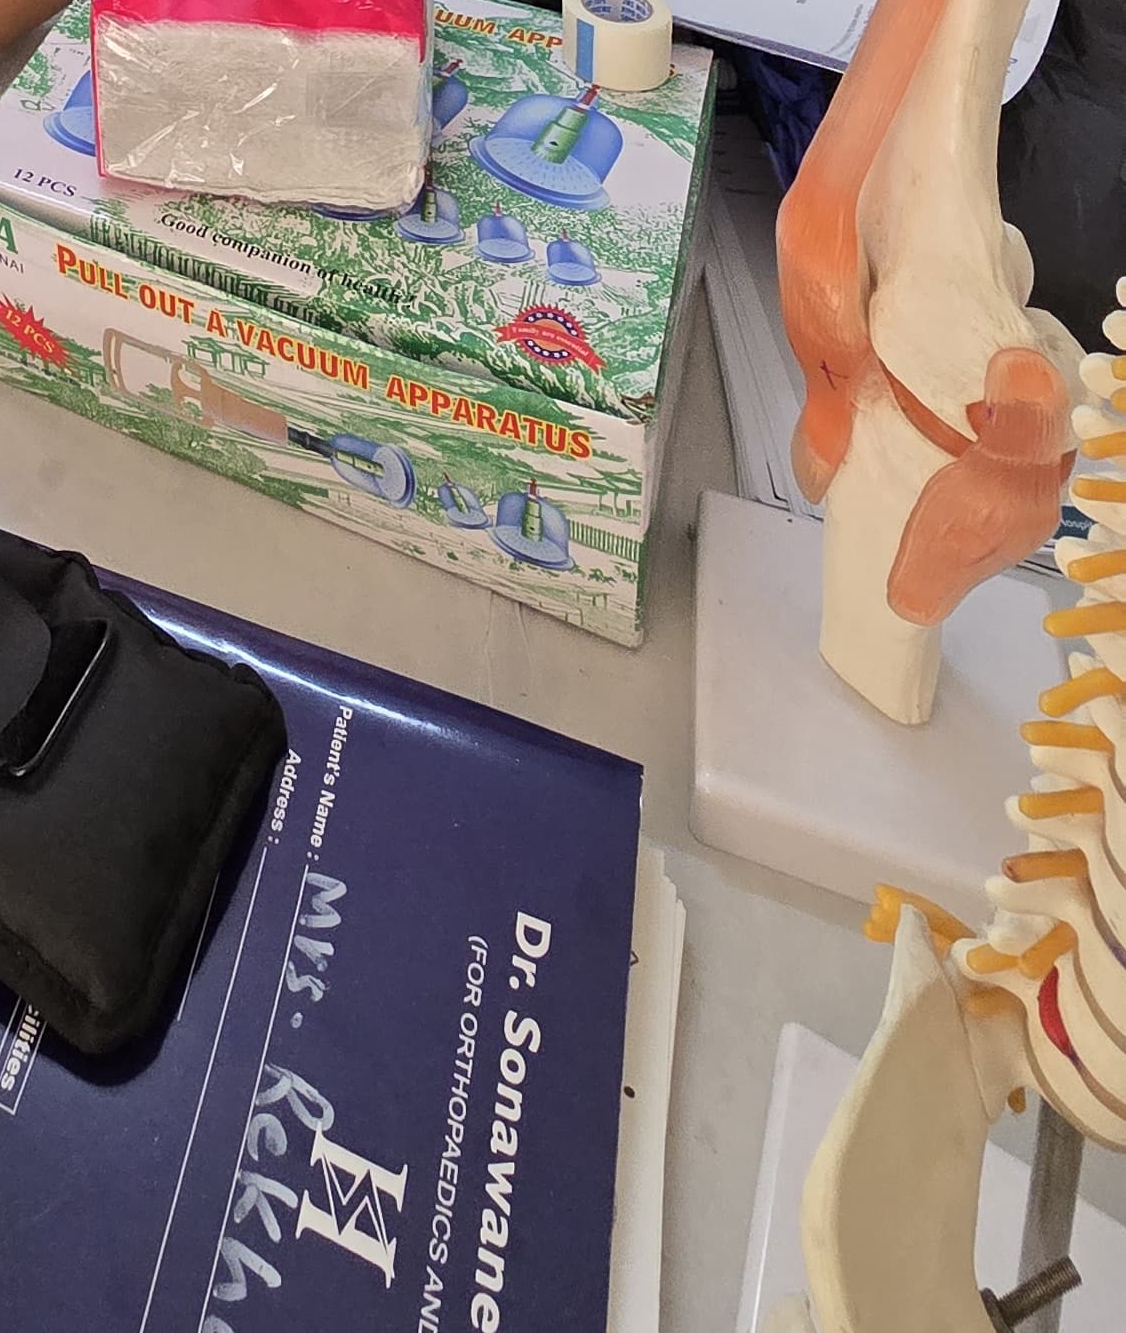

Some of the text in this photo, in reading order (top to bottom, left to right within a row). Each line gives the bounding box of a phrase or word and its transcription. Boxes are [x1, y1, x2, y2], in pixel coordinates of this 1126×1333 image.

[14, 167, 78, 198] 12 PCS
[160, 211, 208, 238] Good
[212, 231, 312, 275] companion
[317, 269, 340, 283] of
[4, 309, 56, 354] 12 PCS
[56, 243, 592, 459] PULL OUT A VACUUM APPARATUS
[323, 705, 354, 789] Patient's
[271, 747, 302, 833] Address
[310, 784, 337, 849] Name
[464, 935, 490, 1011] (FOR
[507, 910, 553, 991] Dr.
[428, 1011, 481, 1264] ORTHOPAEDICS
